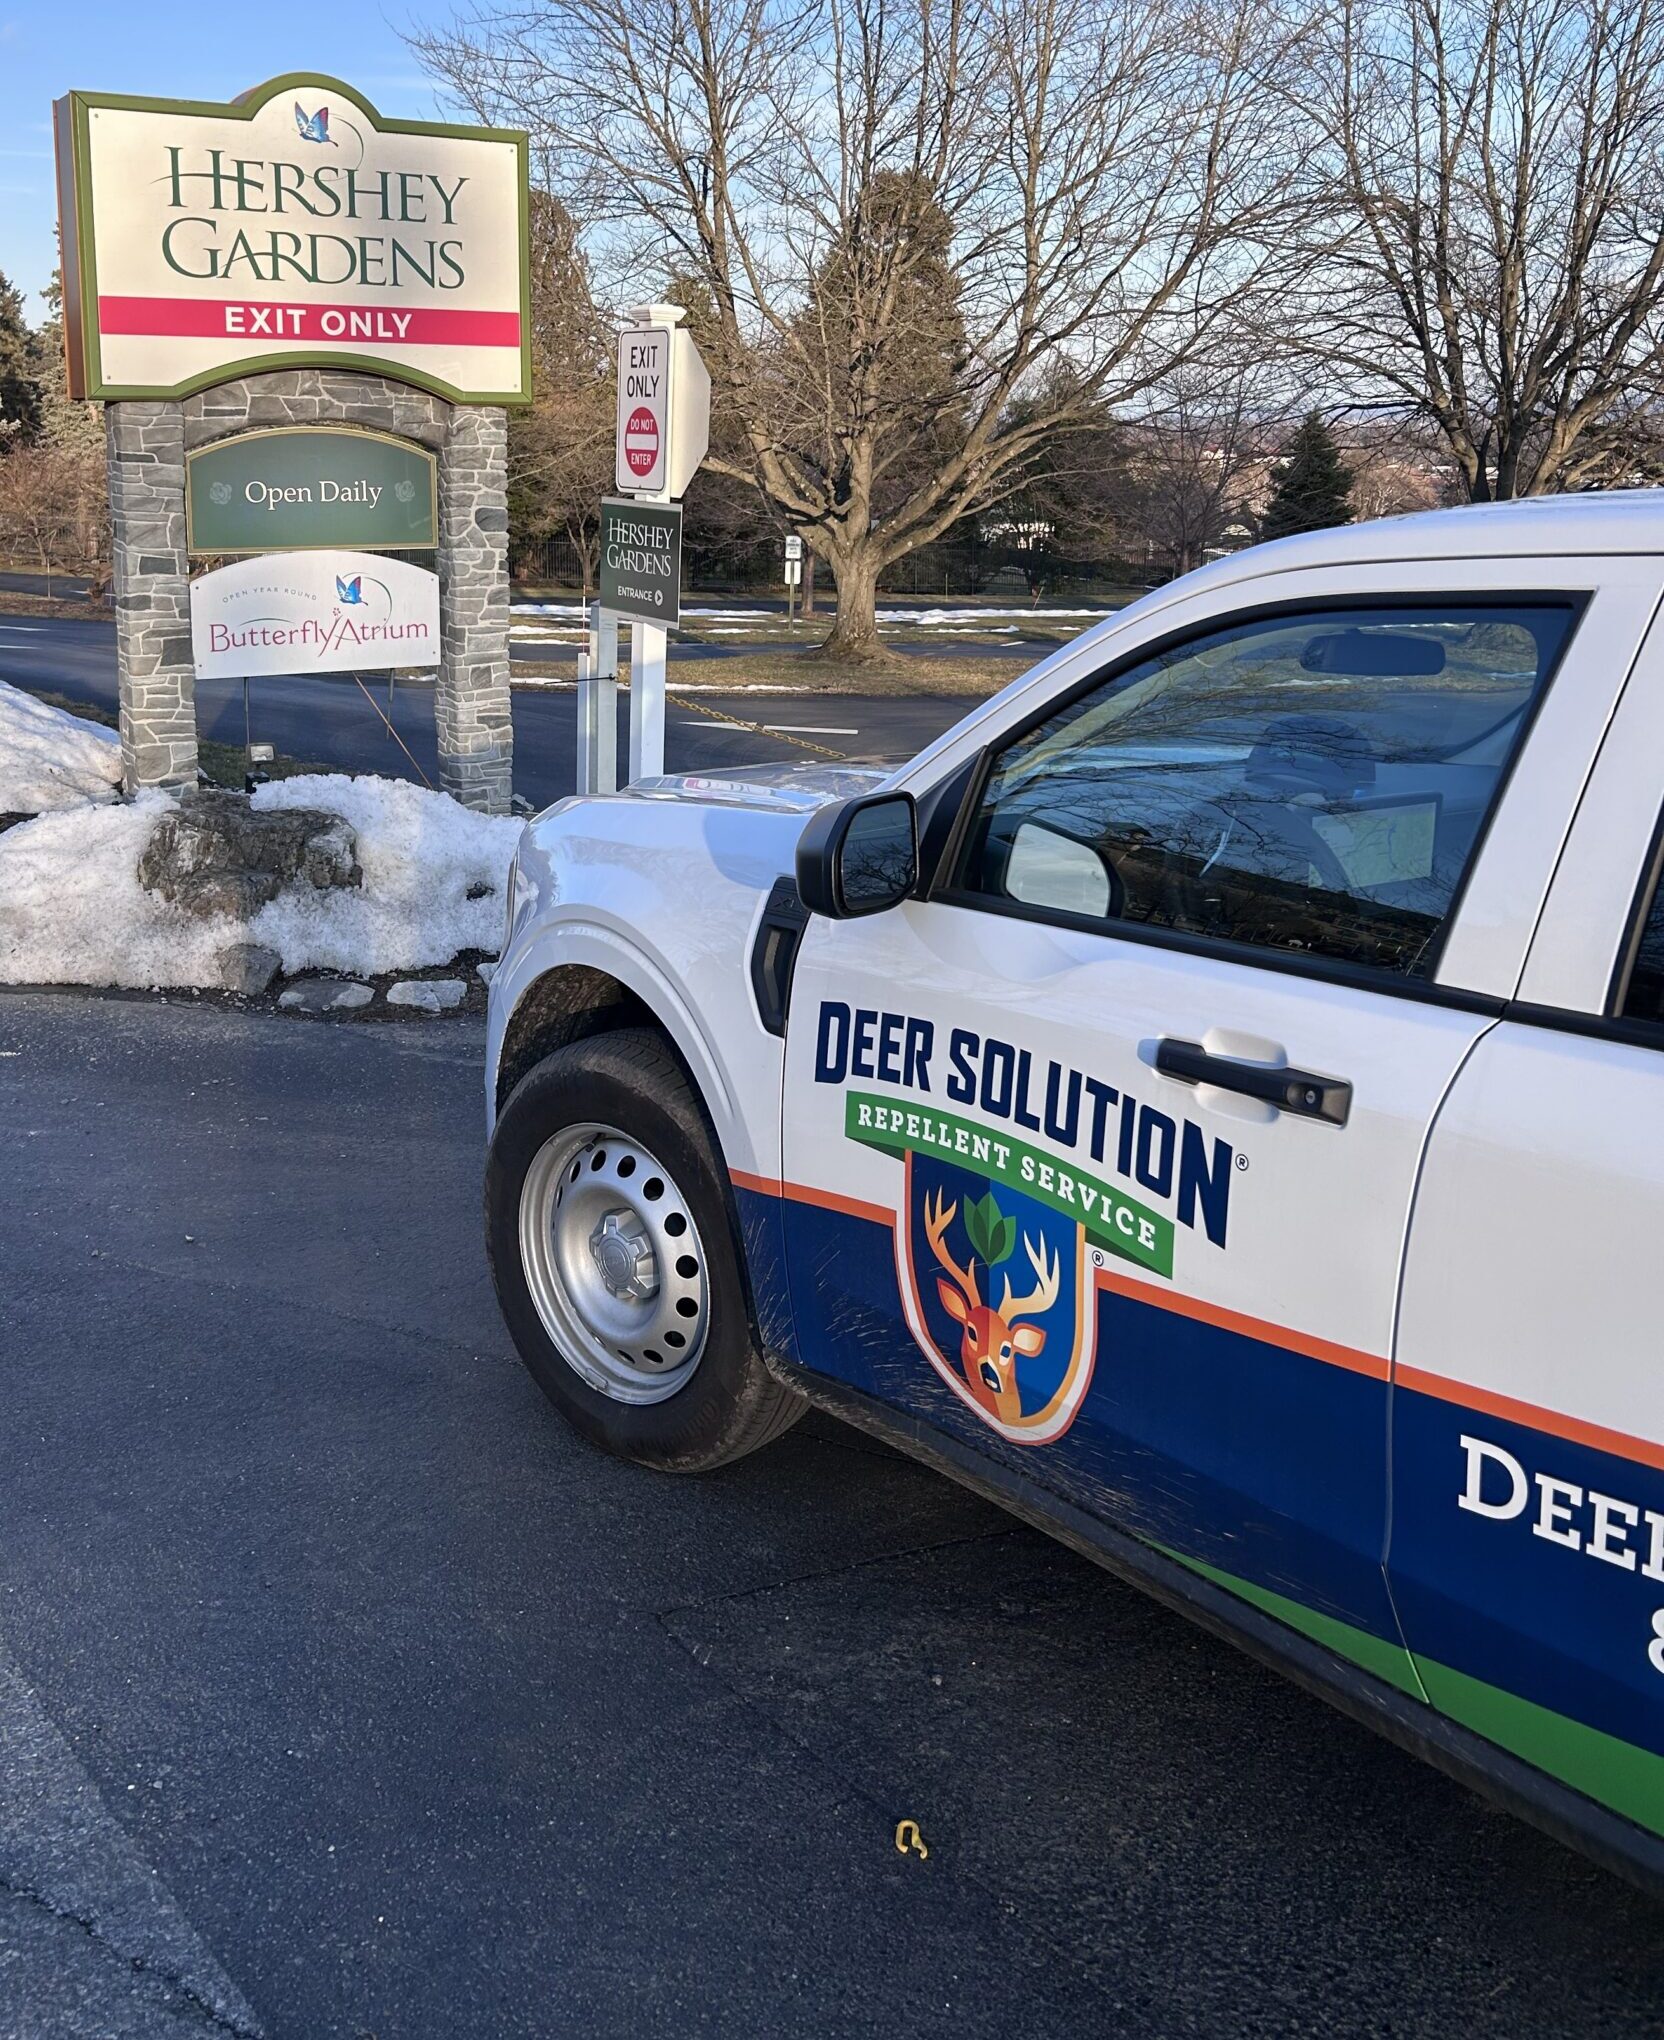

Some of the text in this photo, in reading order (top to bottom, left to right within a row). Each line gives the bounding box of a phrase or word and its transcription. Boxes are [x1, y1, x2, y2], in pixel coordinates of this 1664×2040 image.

[160, 146, 470, 225] HERSHEY
[162, 217, 465, 289] GARDENS
[225, 306, 413, 339] EXIT ONLY
[630, 345, 658, 369] EXIT
[627, 375, 660, 398] ONLY
[630, 418, 654, 432] DO NOT
[631, 453, 652, 466] ENTER
[245, 480, 383, 510] Open Daily
[607, 517, 674, 550] HERSHEY
[606, 544, 672, 577] GARDENS
[222, 586, 317, 603] OPEN YEAR ROUND
[617, 585, 653, 602] ENTRANCE
[209, 616, 429, 657] Butterfly Atrium
[814, 1001, 935, 1092] DEER
[857, 1103, 1156, 1252] REPELLENT SERVICE
